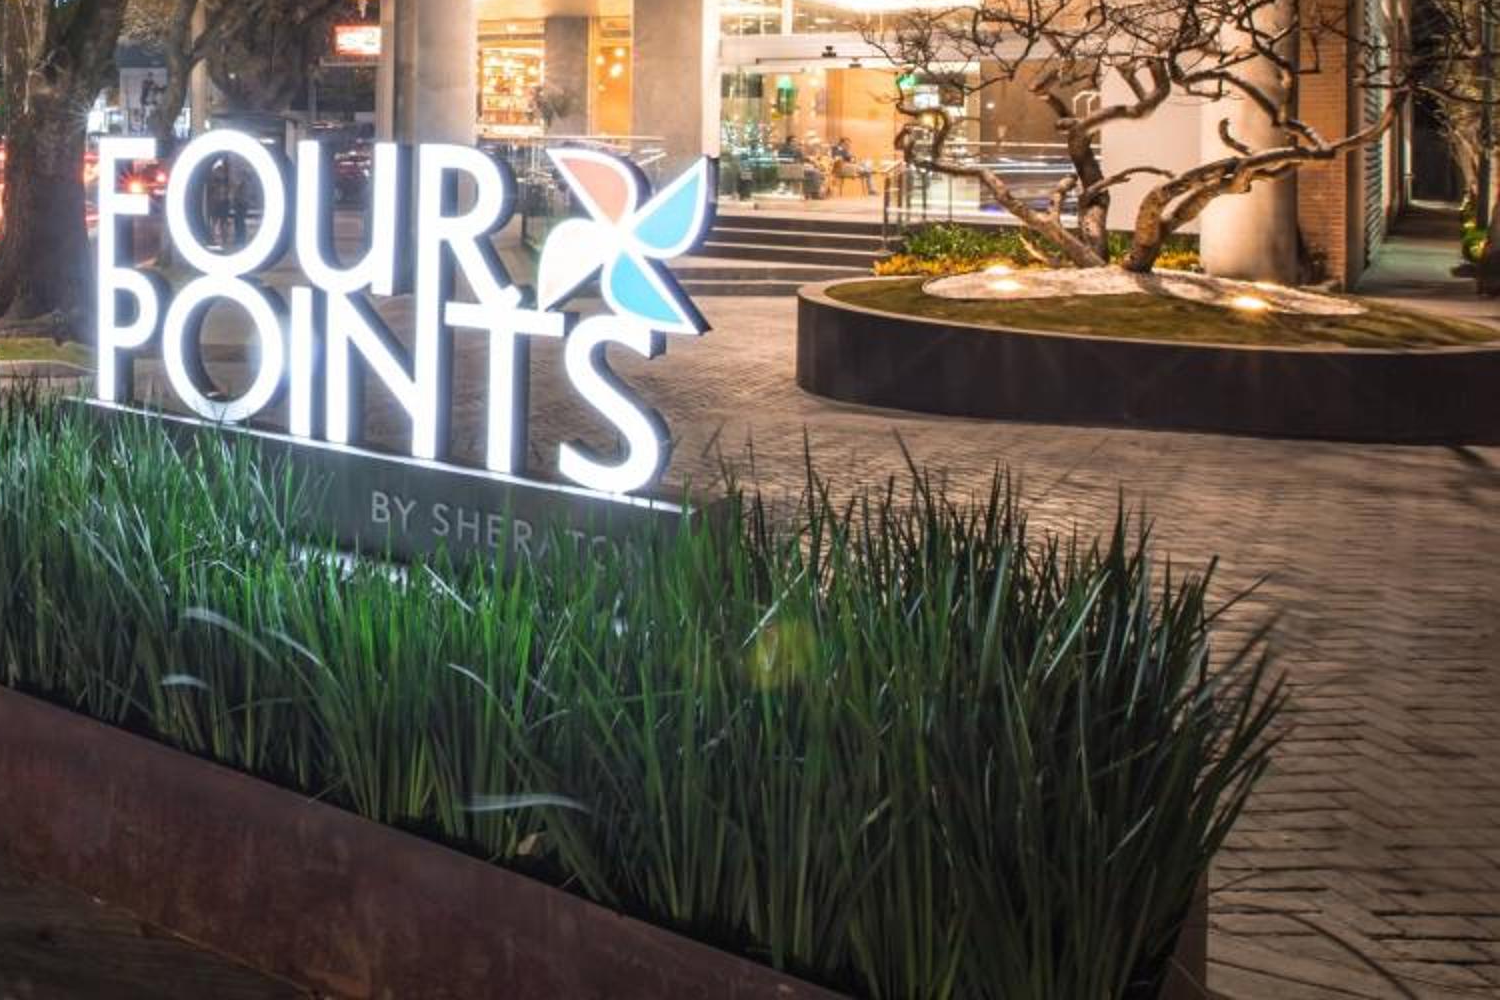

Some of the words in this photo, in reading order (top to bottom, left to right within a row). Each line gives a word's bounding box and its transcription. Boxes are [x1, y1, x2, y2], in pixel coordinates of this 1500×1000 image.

[97, 129, 524, 308] FOUR
[97, 264, 664, 493] POINTS
[370, 490, 417, 531] BY
